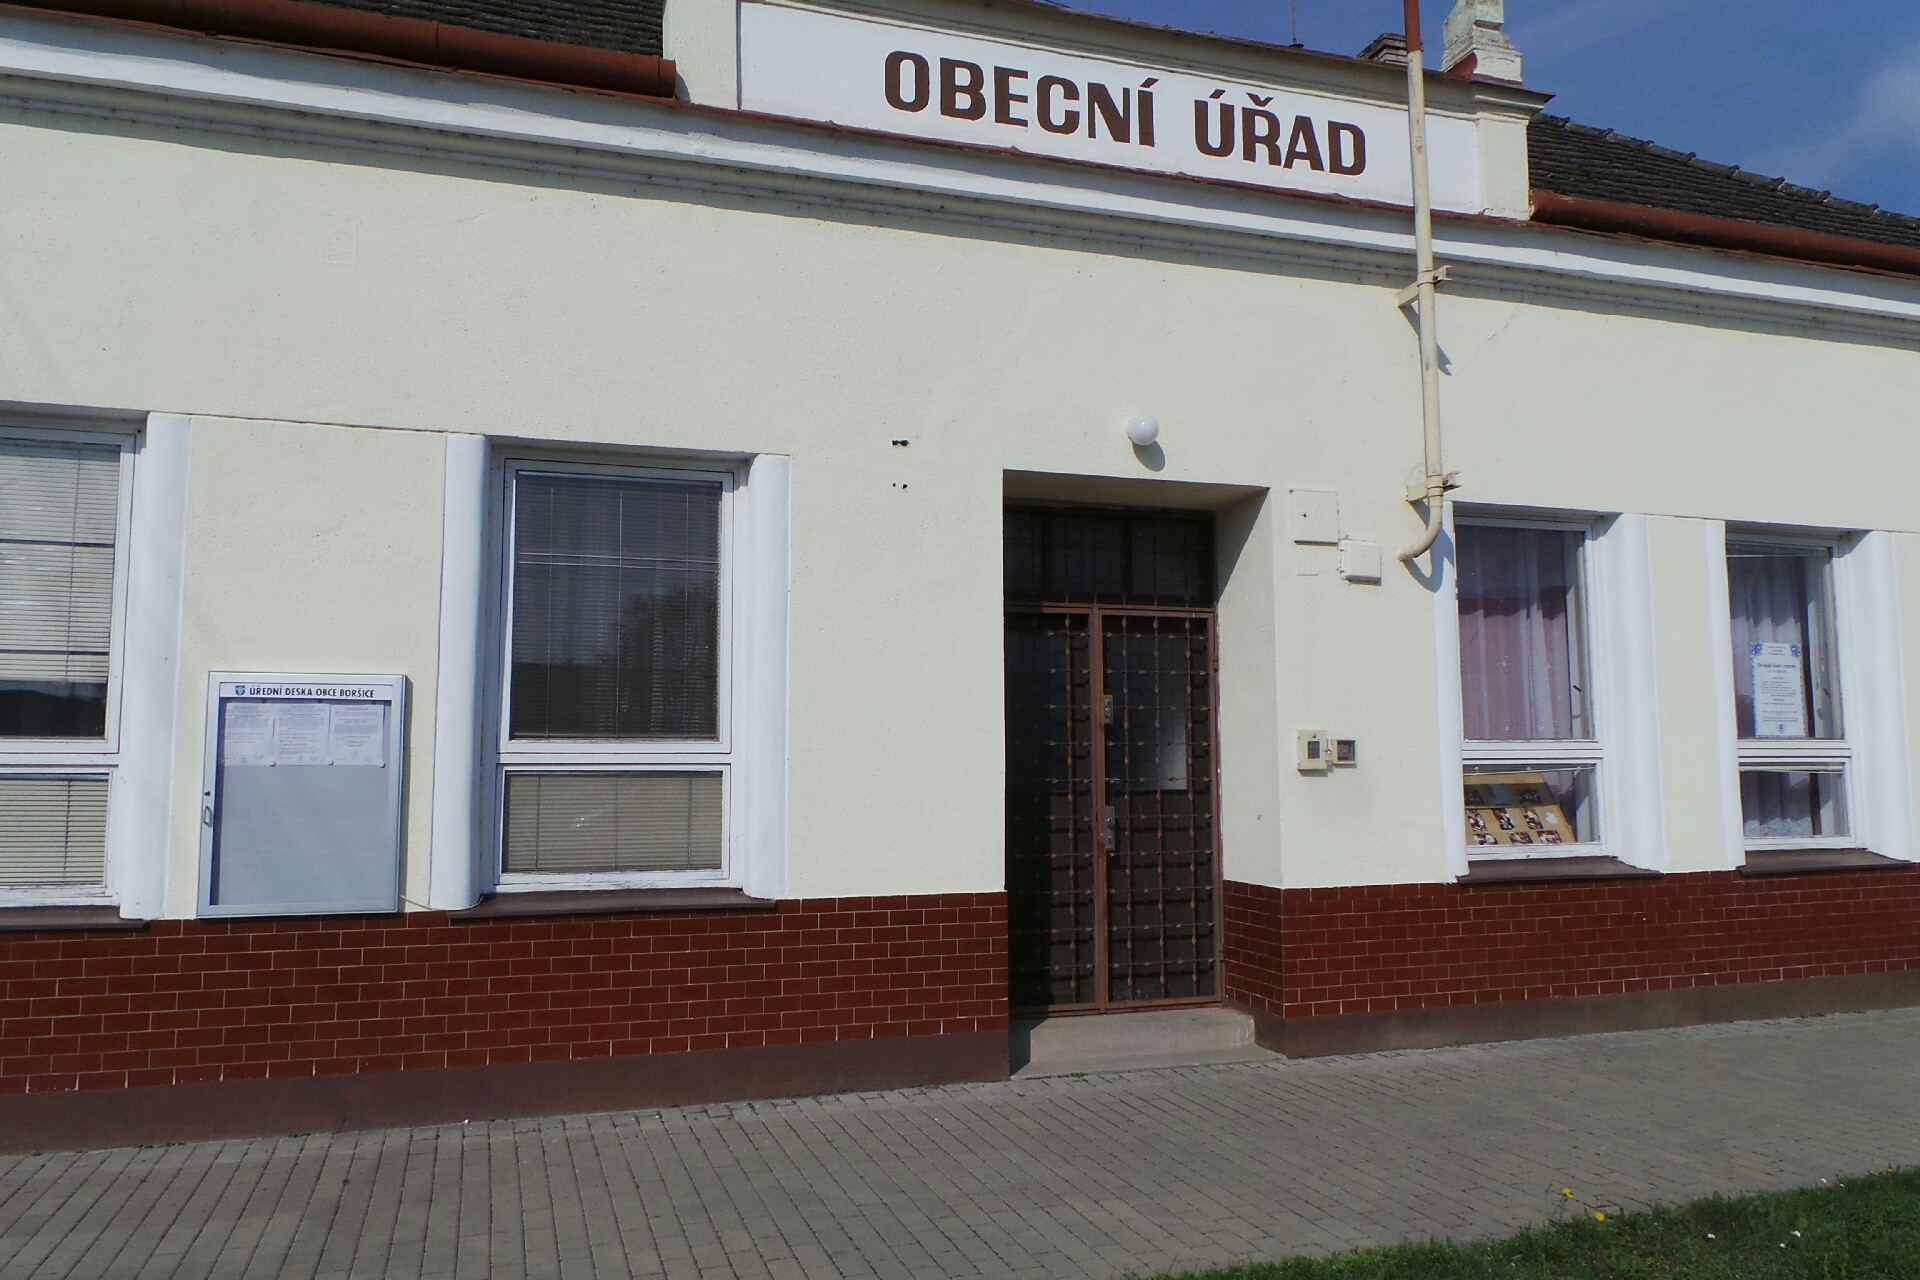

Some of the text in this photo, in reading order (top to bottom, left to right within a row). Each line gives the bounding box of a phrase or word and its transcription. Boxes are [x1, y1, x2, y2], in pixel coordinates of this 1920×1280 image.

[884, 50, 1366, 176] OBECNÍ ÚŘAD
[249, 685, 375, 698] ÚŘEDNÍ DESKA OBCE BORŠICE
